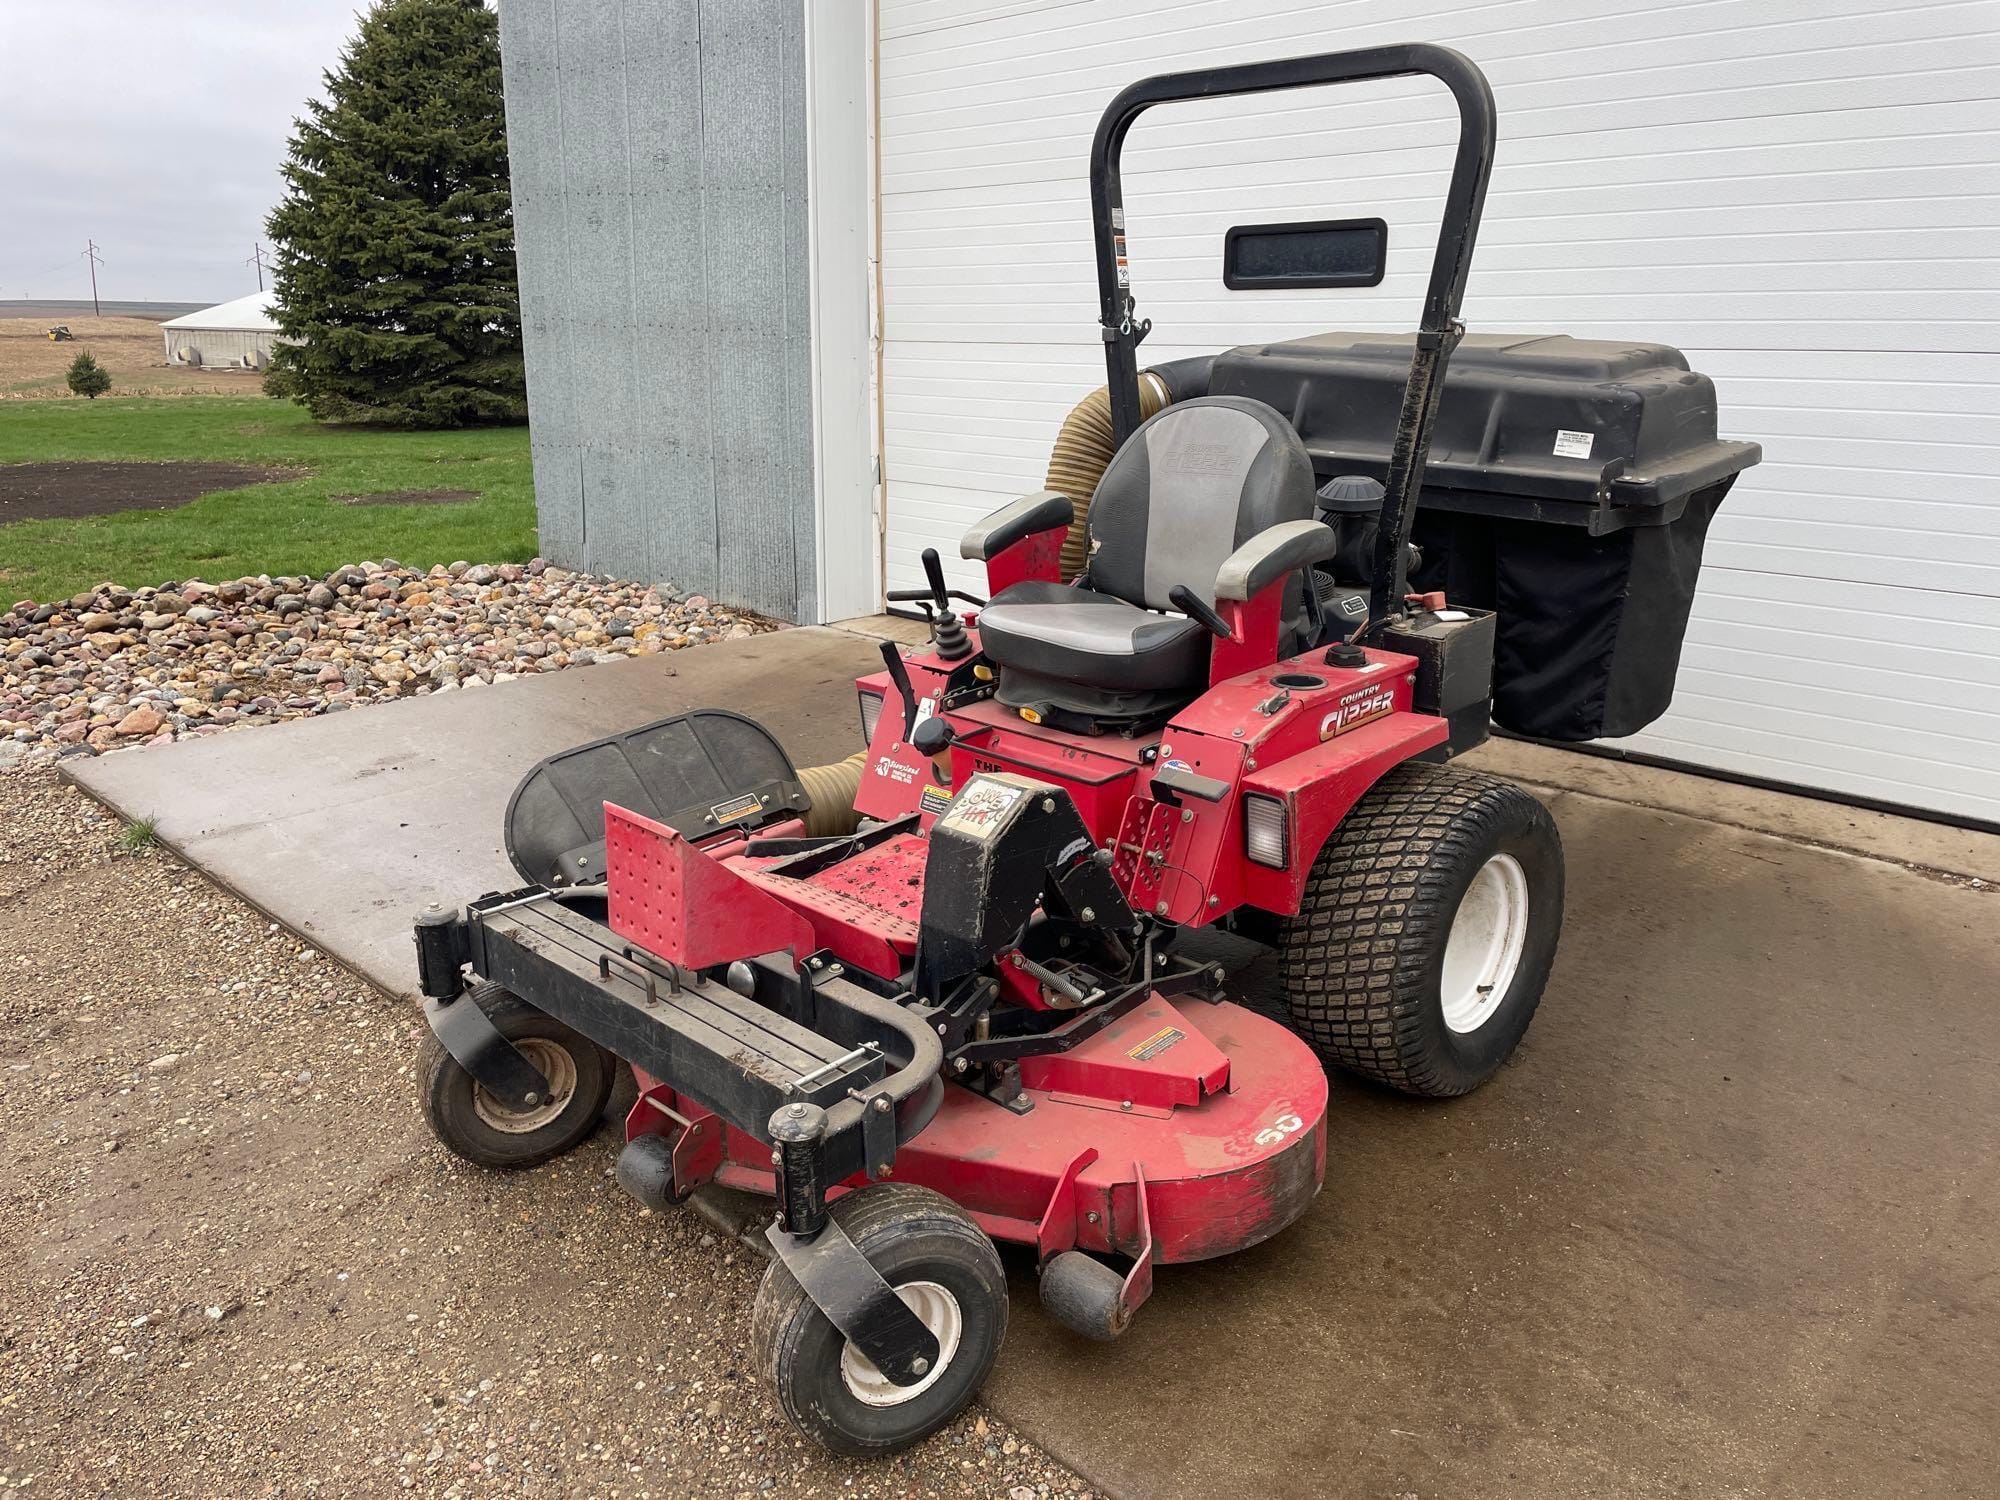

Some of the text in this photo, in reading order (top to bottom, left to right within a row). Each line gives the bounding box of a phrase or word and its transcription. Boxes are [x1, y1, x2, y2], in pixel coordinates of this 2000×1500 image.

[1340, 683, 1381, 706] COUNTRY
[1320, 690, 1394, 742] CLIPPER
[975, 758, 1002, 772] THE
